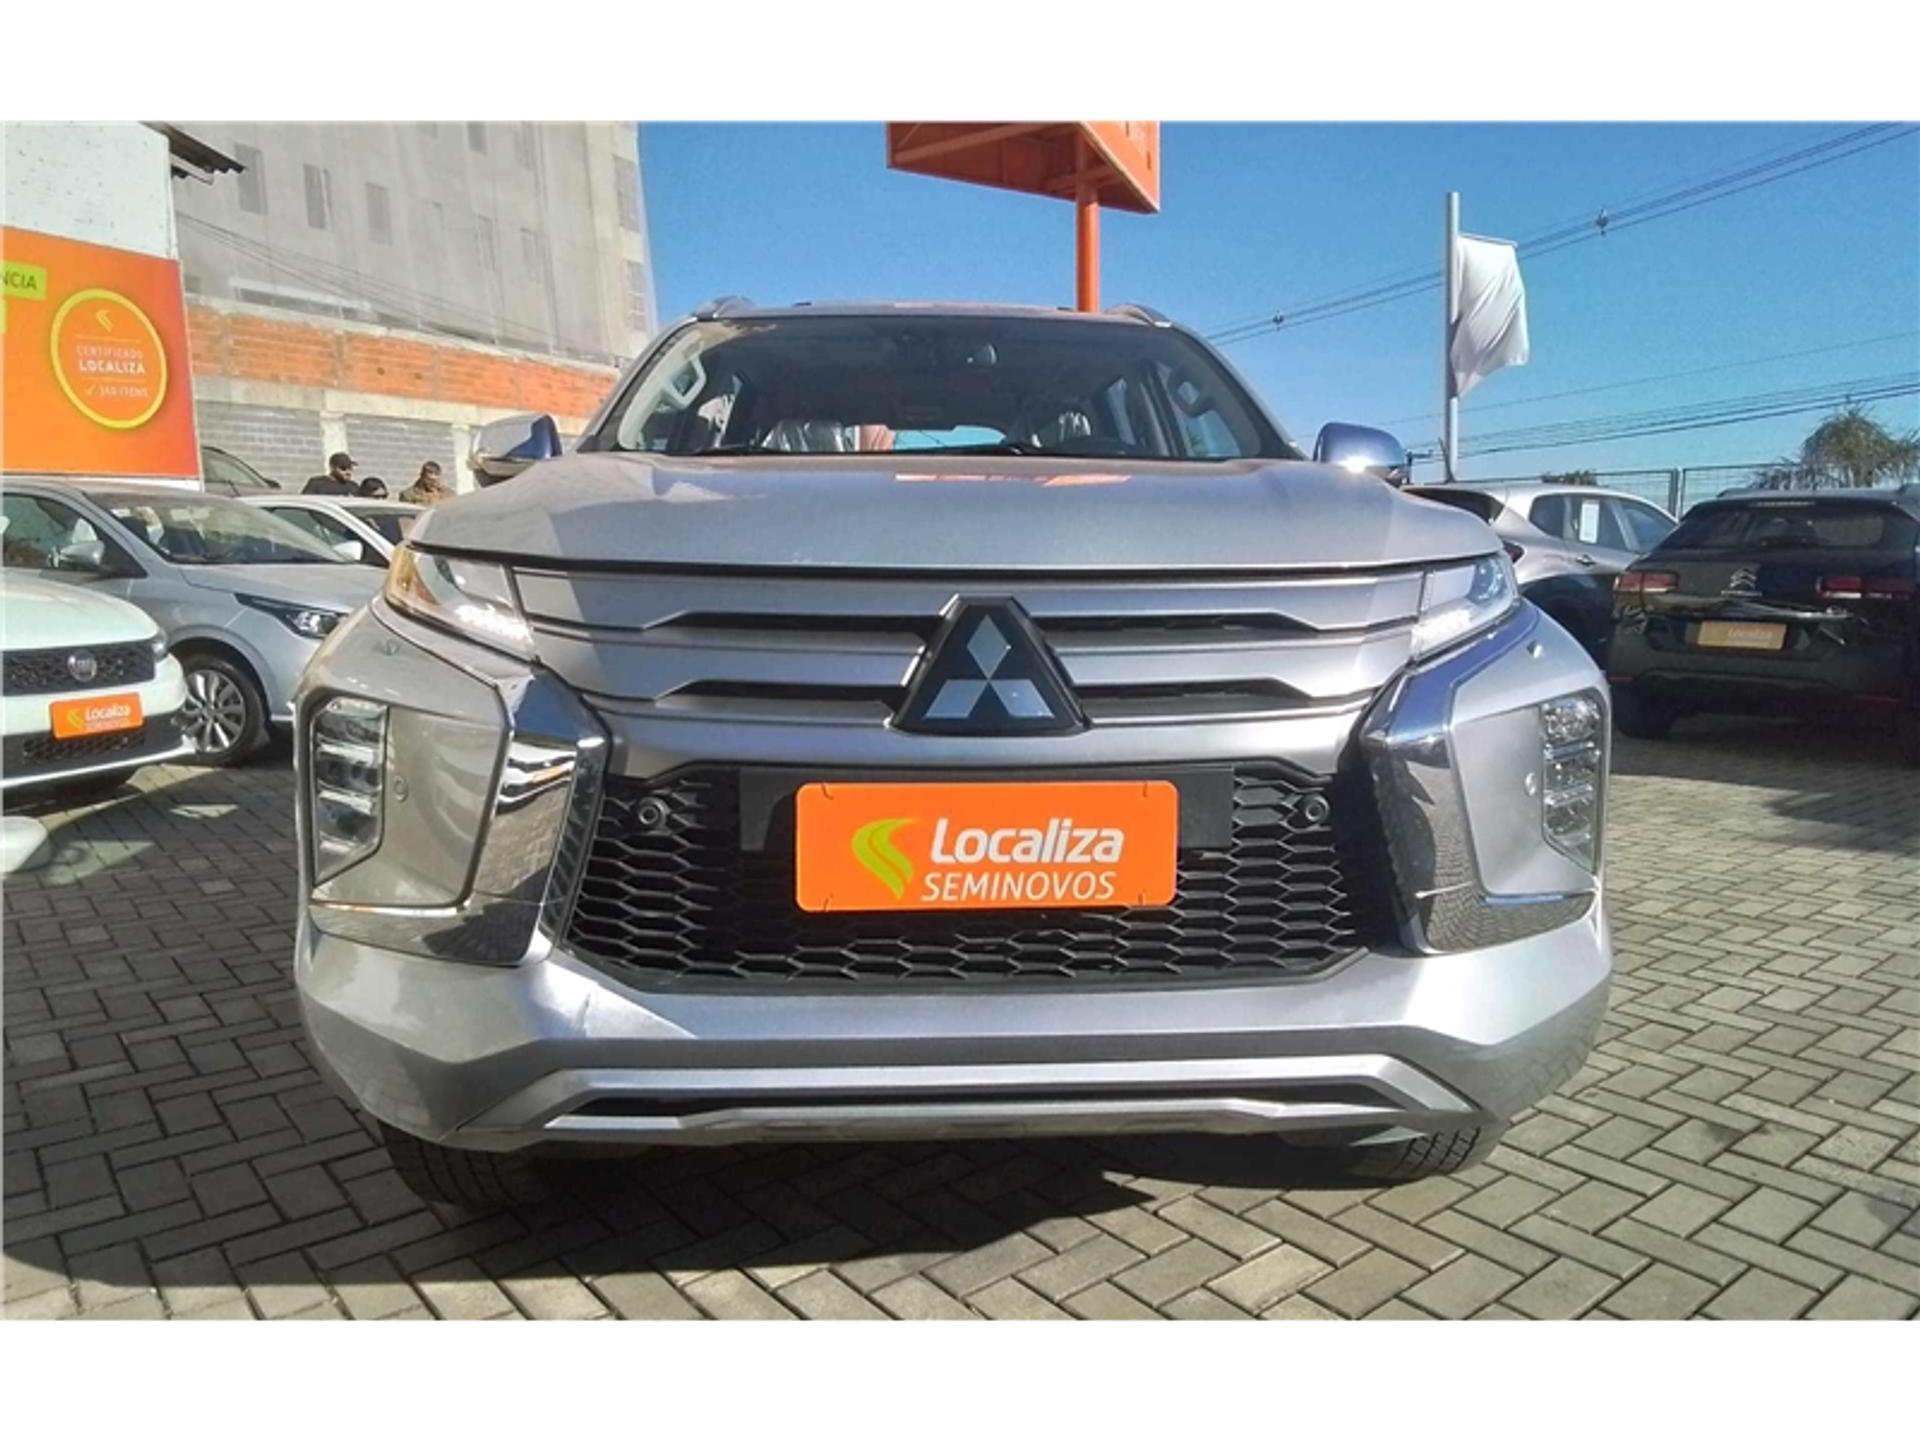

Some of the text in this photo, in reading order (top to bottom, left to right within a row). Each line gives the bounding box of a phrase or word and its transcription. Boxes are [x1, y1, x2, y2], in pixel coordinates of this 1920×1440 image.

[79, 359, 146, 374] LOCALIZA
[85, 704, 130, 722] Localiza
[930, 818, 1124, 864] Localiza
[921, 871, 1117, 901] SEMINOVOS
